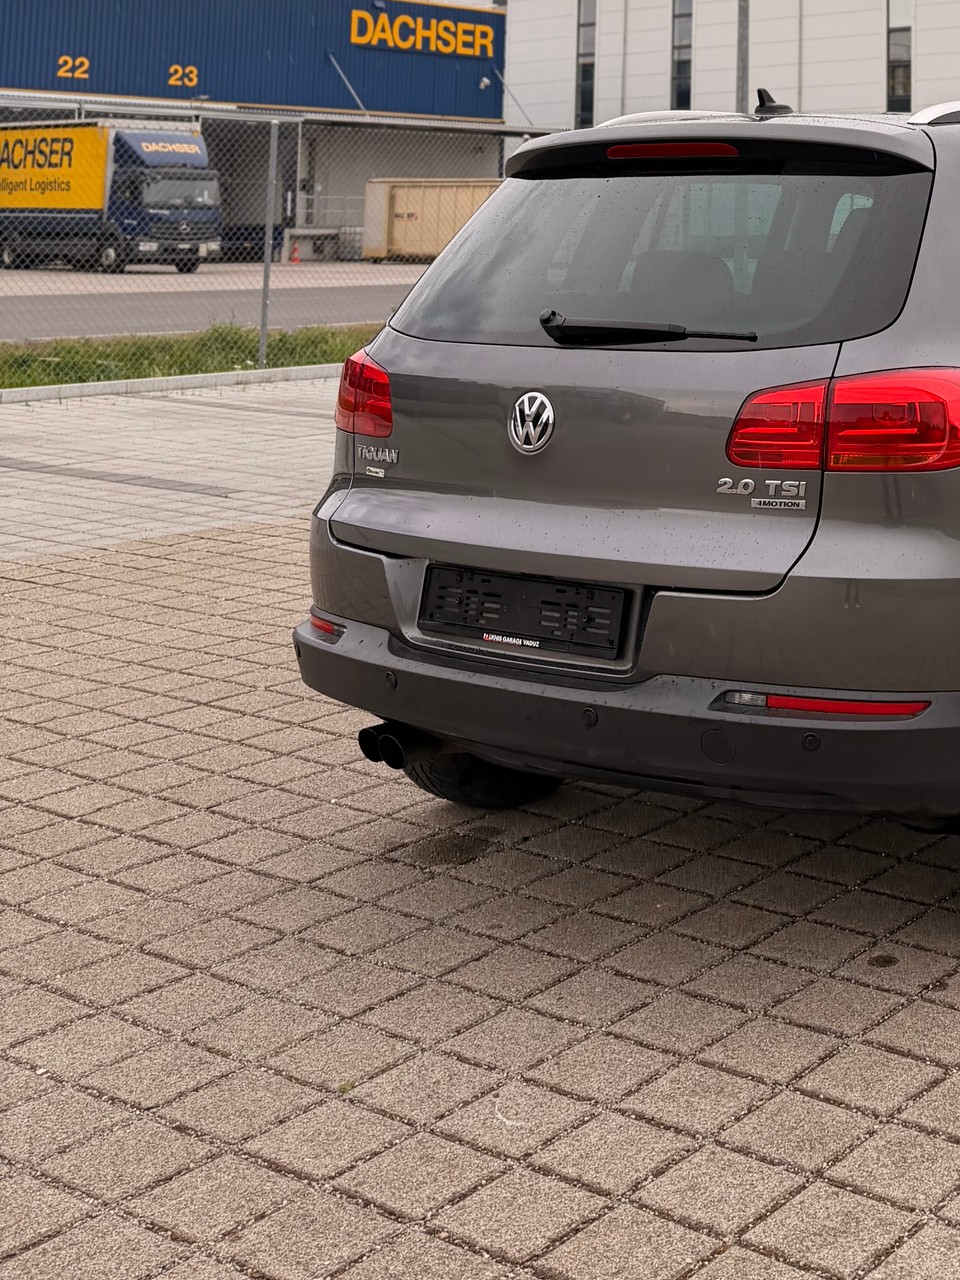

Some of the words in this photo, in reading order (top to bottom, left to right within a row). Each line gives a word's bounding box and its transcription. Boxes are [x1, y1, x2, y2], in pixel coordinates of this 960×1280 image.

[350, 9, 495, 58] DACHSER
[56, 55, 90, 79] 22
[167, 64, 198, 87] 23
[141, 142, 201, 154] DACHSER
[0, 177, 27, 195] lligent
[29, 176, 71, 195] Logistics
[508, 391, 555, 455] VW
[357, 444, 399, 464] TIGUAN
[716, 477, 755, 495] 2.0
[764, 480, 807, 497] TSI
[756, 500, 800, 508] 4MOTION
[502, 636, 522, 645] GARAGE
[523, 639, 540, 648] VADUZ
